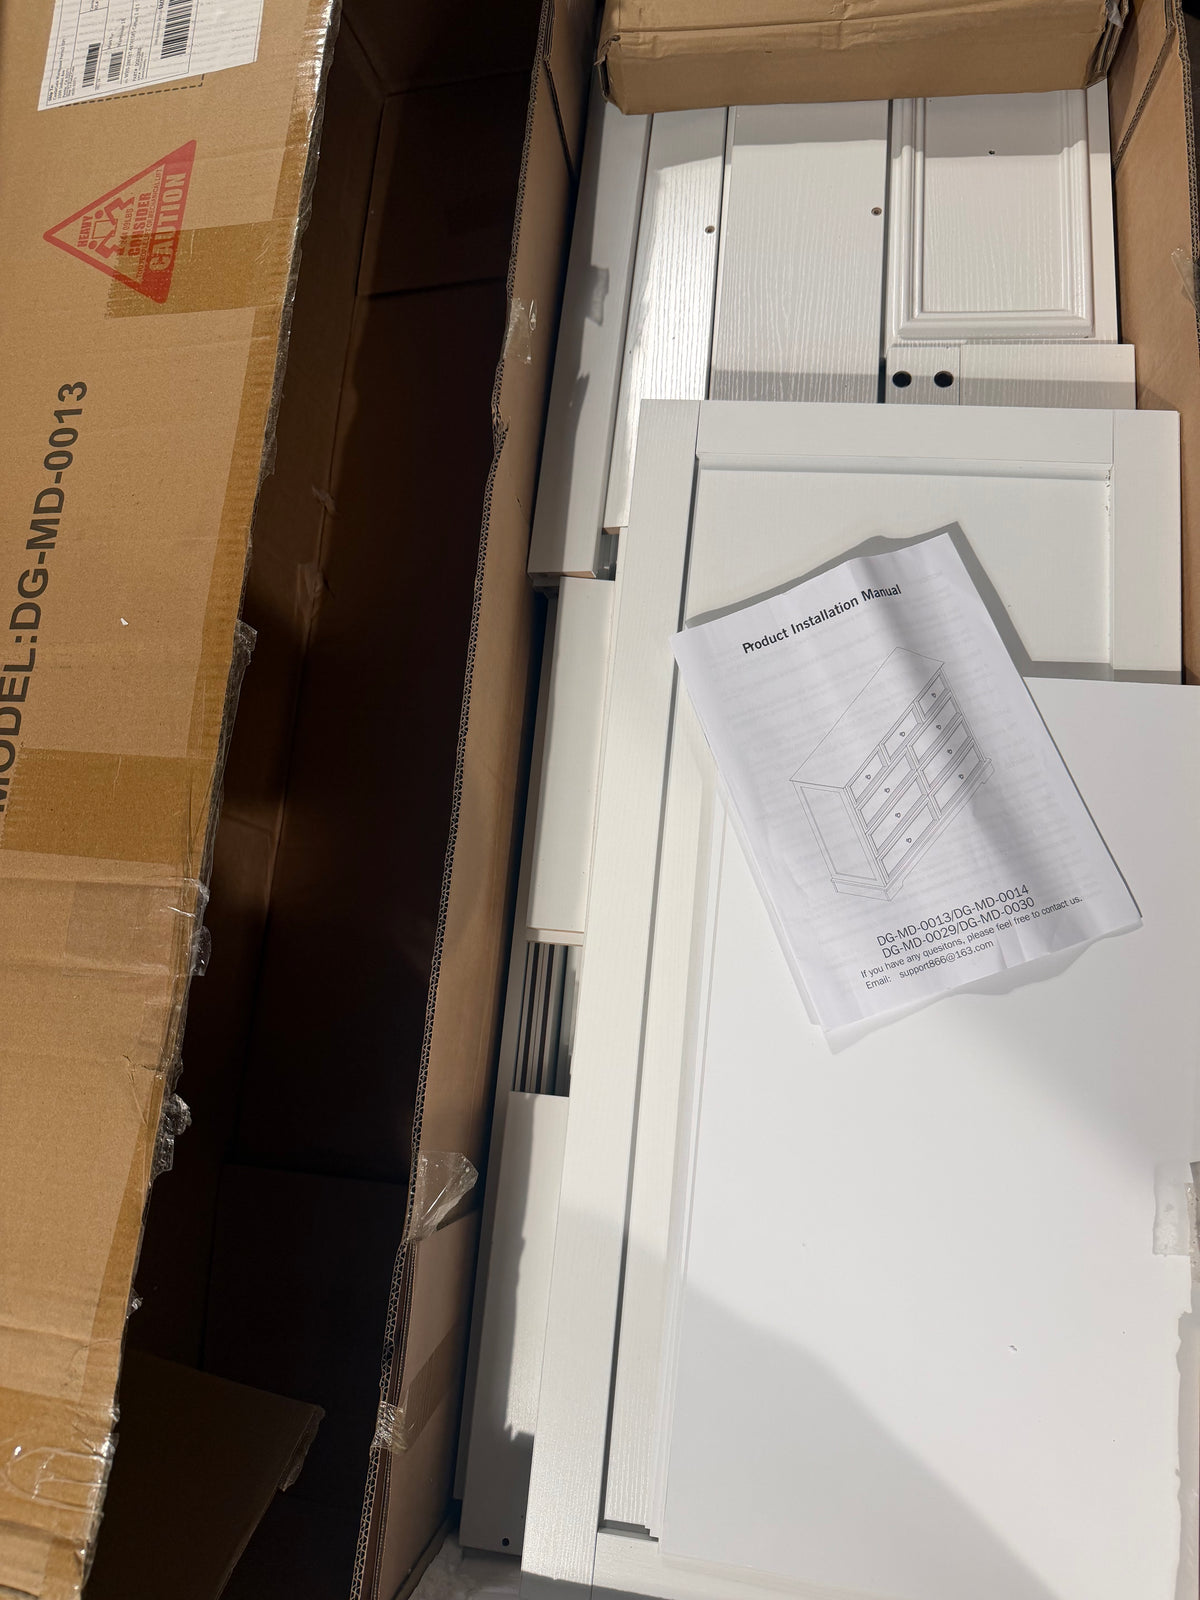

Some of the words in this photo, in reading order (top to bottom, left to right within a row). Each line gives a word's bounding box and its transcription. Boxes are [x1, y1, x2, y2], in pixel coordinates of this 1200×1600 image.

[128, 192, 152, 256] CONSIDER
[146, 180, 161, 219] MECHANICAL
[151, 172, 186, 271] CAUTION
[77, 215, 93, 248] HEAVY
[742, 628, 790, 655] Product
[791, 596, 859, 634] Installation
[861, 584, 902, 602] Manual
[860, 969, 868, 979] If
[868, 966, 884, 978] you
[884, 956, 906, 972] have
[906, 952, 922, 966] any
[923, 938, 966, 961] quesitons,
[966, 926, 995, 944] please
[996, 920, 1013, 934] feel
[1014, 914, 1031, 928] free
[1031, 910, 1041, 920] to
[1041, 901, 1069, 916] contact
[1069, 896, 1084, 908] us.
[877, 884, 1030, 947] DG-MD-0013/DG-MD-0014
[882, 896, 1036, 959] DG-MD-0029/DG-MD-0030
[865, 974, 892, 990] Email:
[899, 939, 995, 980] support866@163.com
